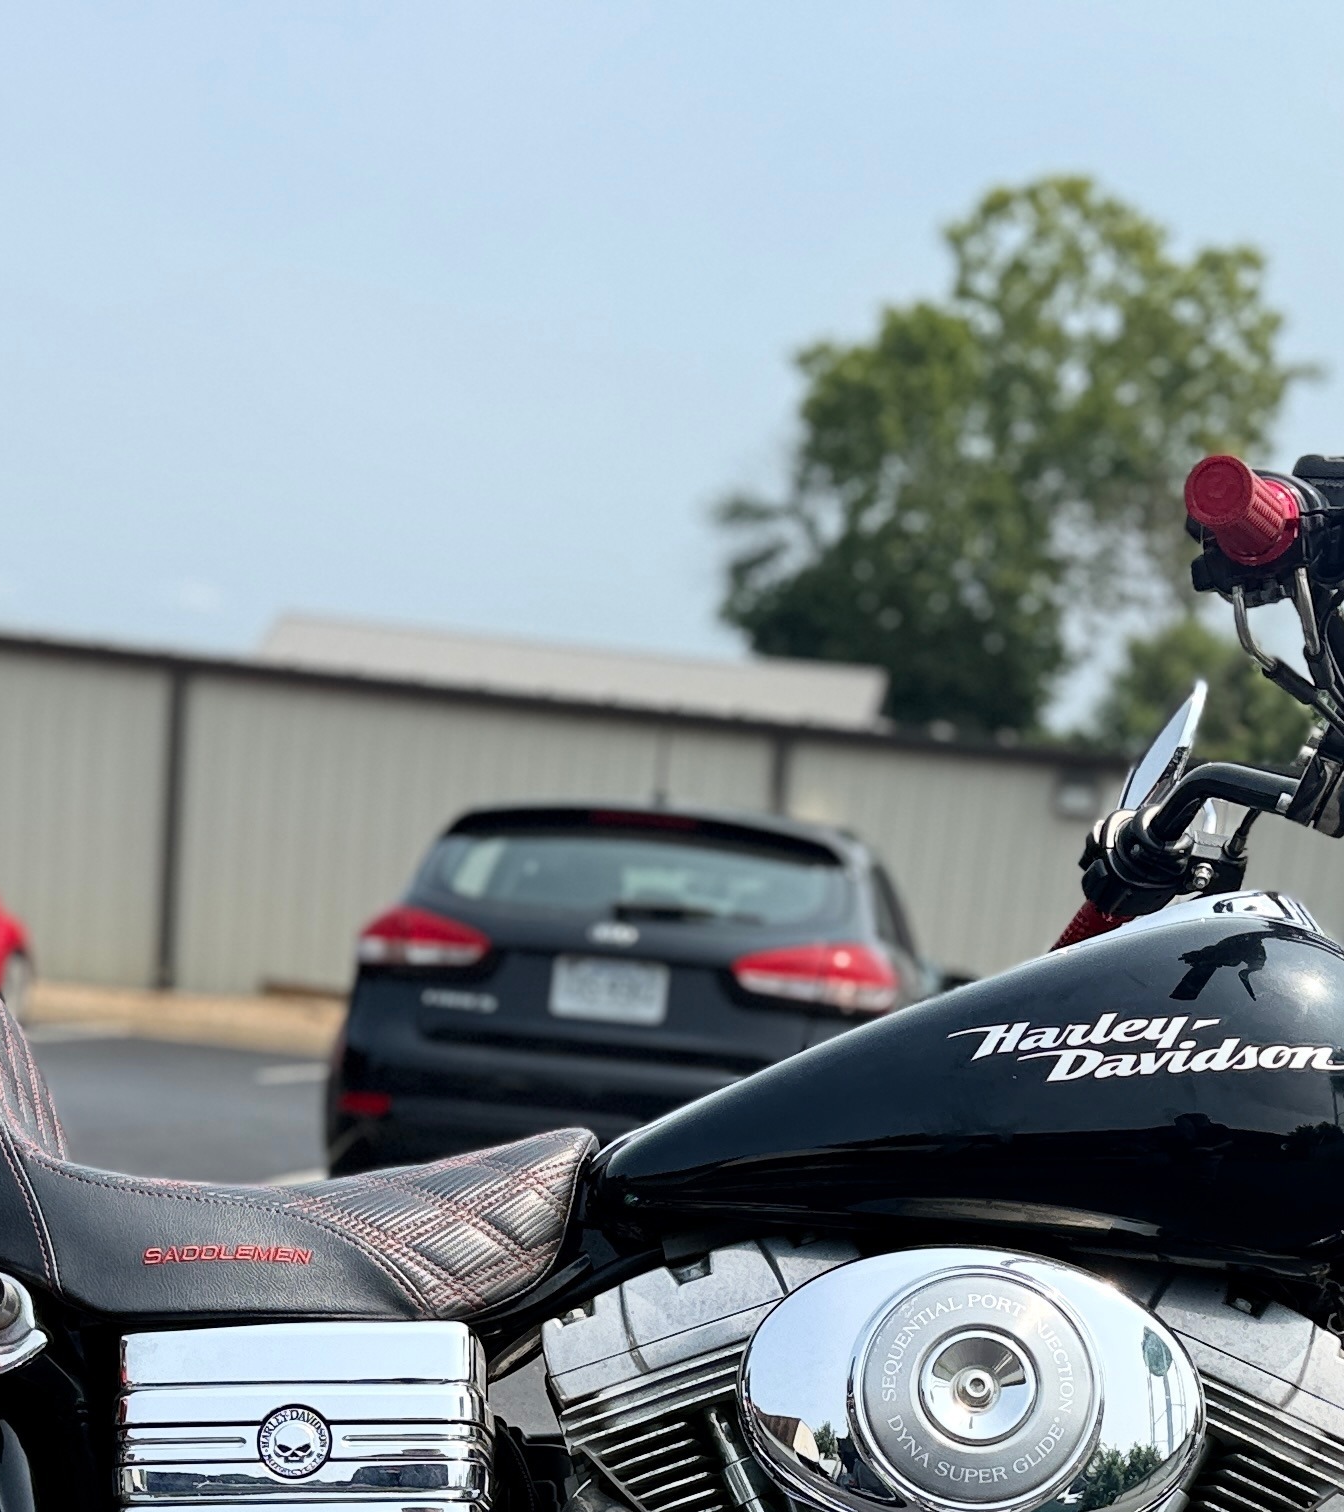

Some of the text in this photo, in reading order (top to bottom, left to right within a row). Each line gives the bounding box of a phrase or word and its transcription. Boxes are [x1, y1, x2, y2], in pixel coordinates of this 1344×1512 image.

[142, 1244, 314, 1266] SADDLEMEN
[881, 1292, 1075, 1415] SEQUENTIAL PORT NJECTION
[886, 1414, 1064, 1484] DYNA SUPER GLIDE
